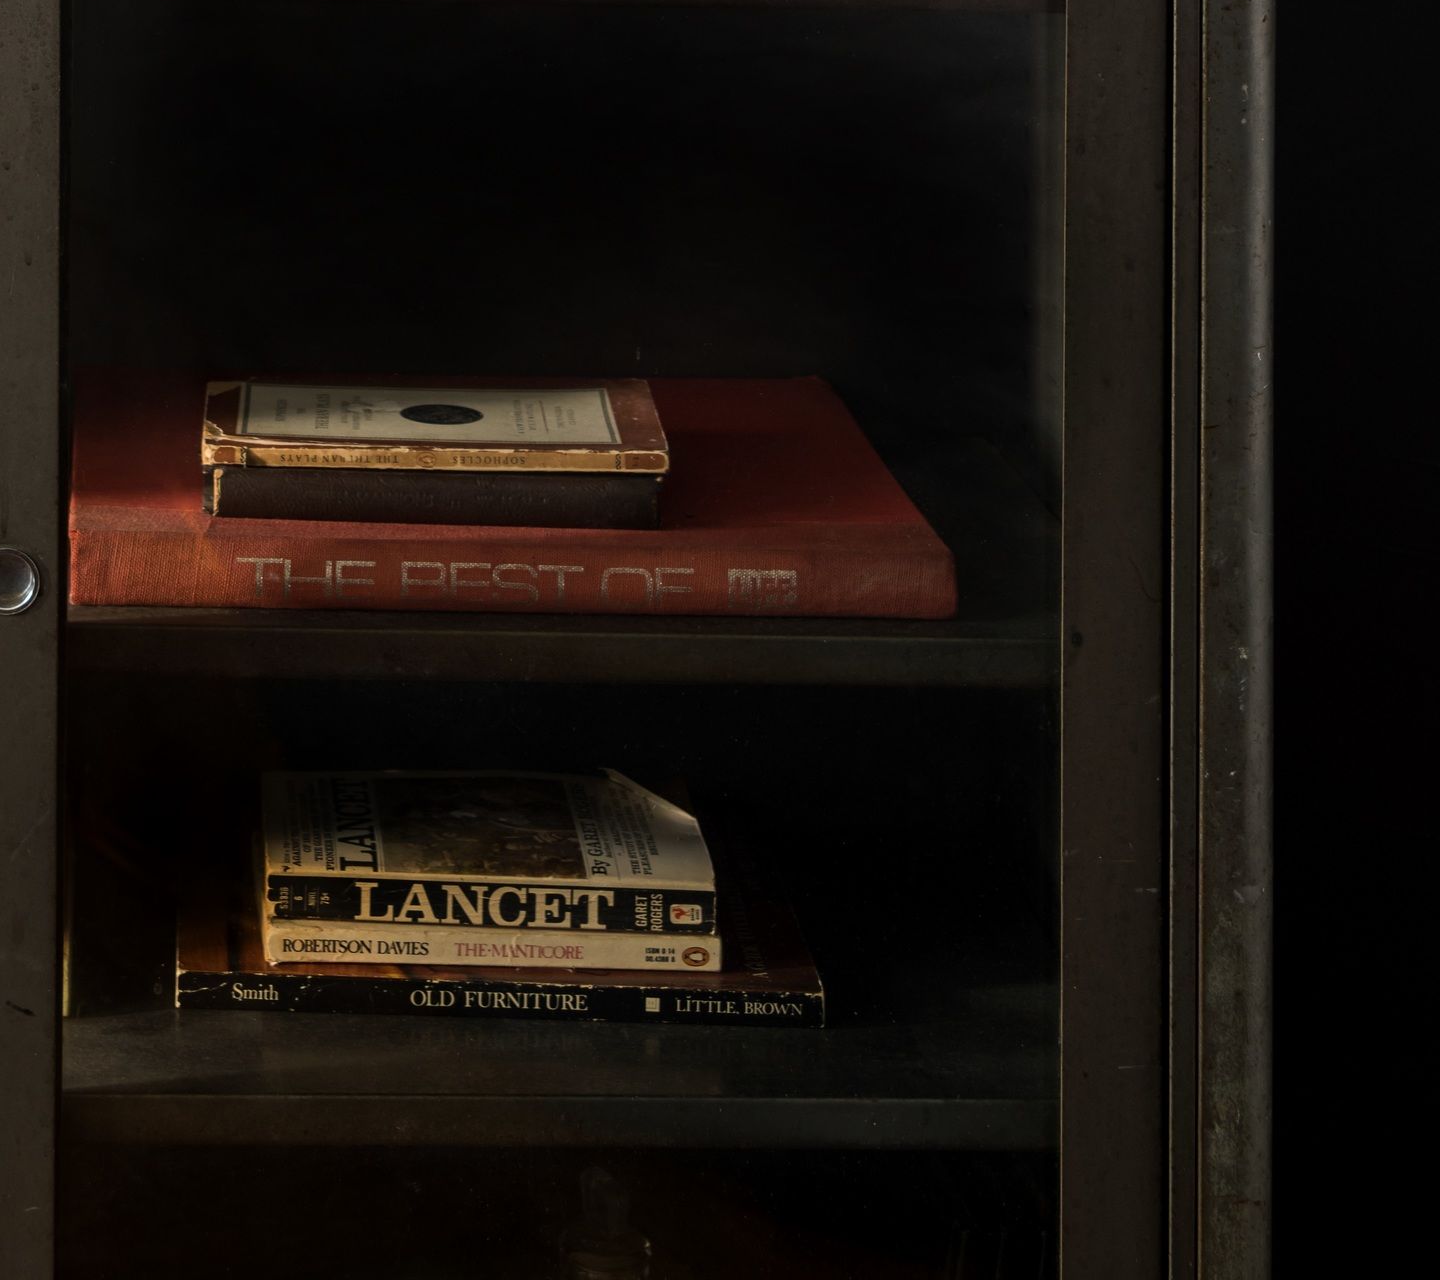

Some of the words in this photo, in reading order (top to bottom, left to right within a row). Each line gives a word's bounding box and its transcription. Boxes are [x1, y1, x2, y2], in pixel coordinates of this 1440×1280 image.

[452, 455, 526, 465] SOPHOCLES
[235, 557, 376, 602] THE
[401, 560, 585, 605] BEST
[600, 566, 696, 607] OF
[333, 778, 378, 873] LANCET
[581, 821, 602, 856] GARET
[591, 859, 611, 875] By
[352, 880, 616, 930] LANCET
[635, 894, 648, 930] GARET
[649, 893, 664, 933] ROGERS
[282, 937, 374, 956] ROBERTSON
[376, 938, 430, 958] DAVIES
[230, 981, 280, 1002] Smith
[408, 989, 456, 1009] OLD
[462, 990, 588, 1012] FURNITURE
[742, 1000, 804, 1018] BROWN
